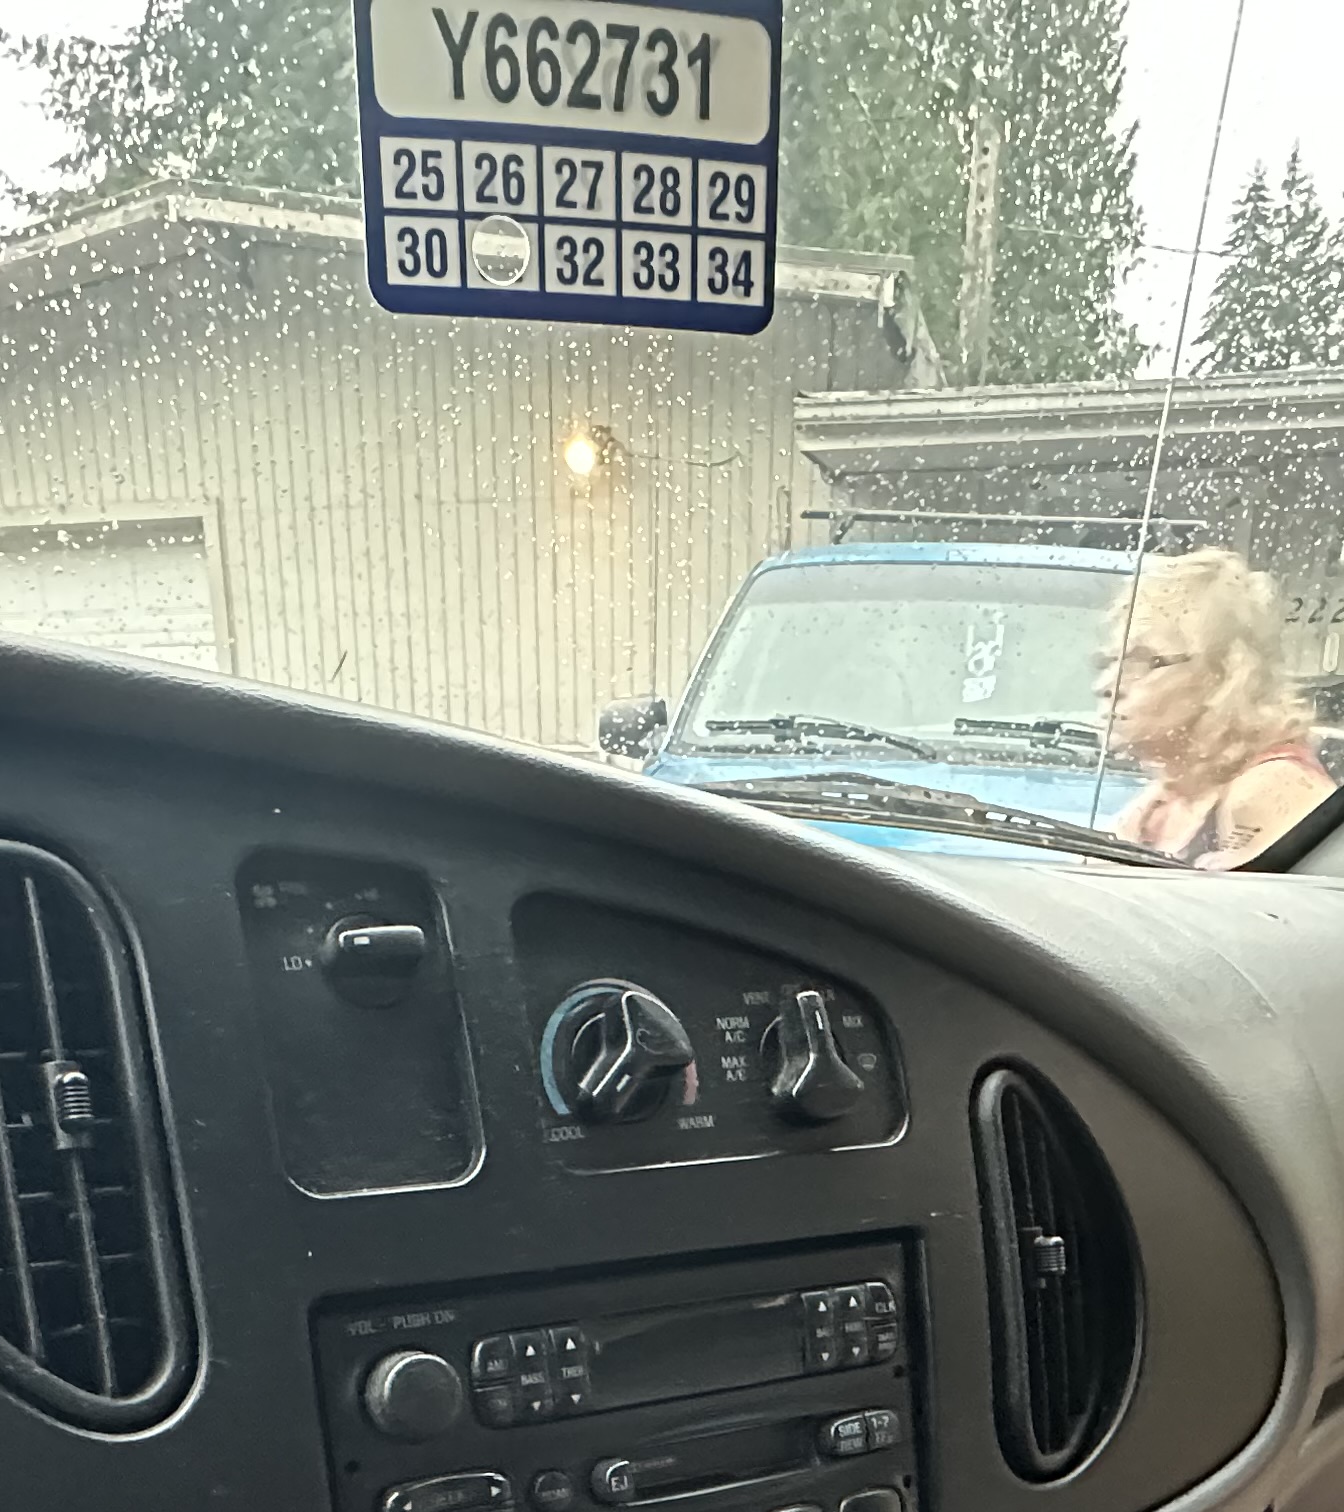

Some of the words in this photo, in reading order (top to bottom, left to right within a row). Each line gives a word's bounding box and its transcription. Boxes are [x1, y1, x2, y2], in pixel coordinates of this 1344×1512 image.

[431, 7, 712, 121] Y662731
[391, 147, 446, 202] 25
[473, 151, 527, 206] 26
[554, 156, 605, 211] 27
[632, 162, 682, 218] 28
[707, 170, 756, 224] 29
[396, 226, 450, 279] 30
[555, 234, 606, 287] 32
[632, 240, 681, 292] 33
[706, 245, 755, 298] 34
[283, 955, 303, 972] LO
[715, 1016, 751, 1031] NORM
[724, 1030, 747, 1044] A/C
[721, 1055, 748, 1070] MAX
[677, 1115, 716, 1131] WARM
[392, 1311, 432, 1330] PUSH
[520, 1372, 545, 1387] BASS
[837, 1421, 863, 1438] SIDE
[610, 1475, 628, 1493] EJ
